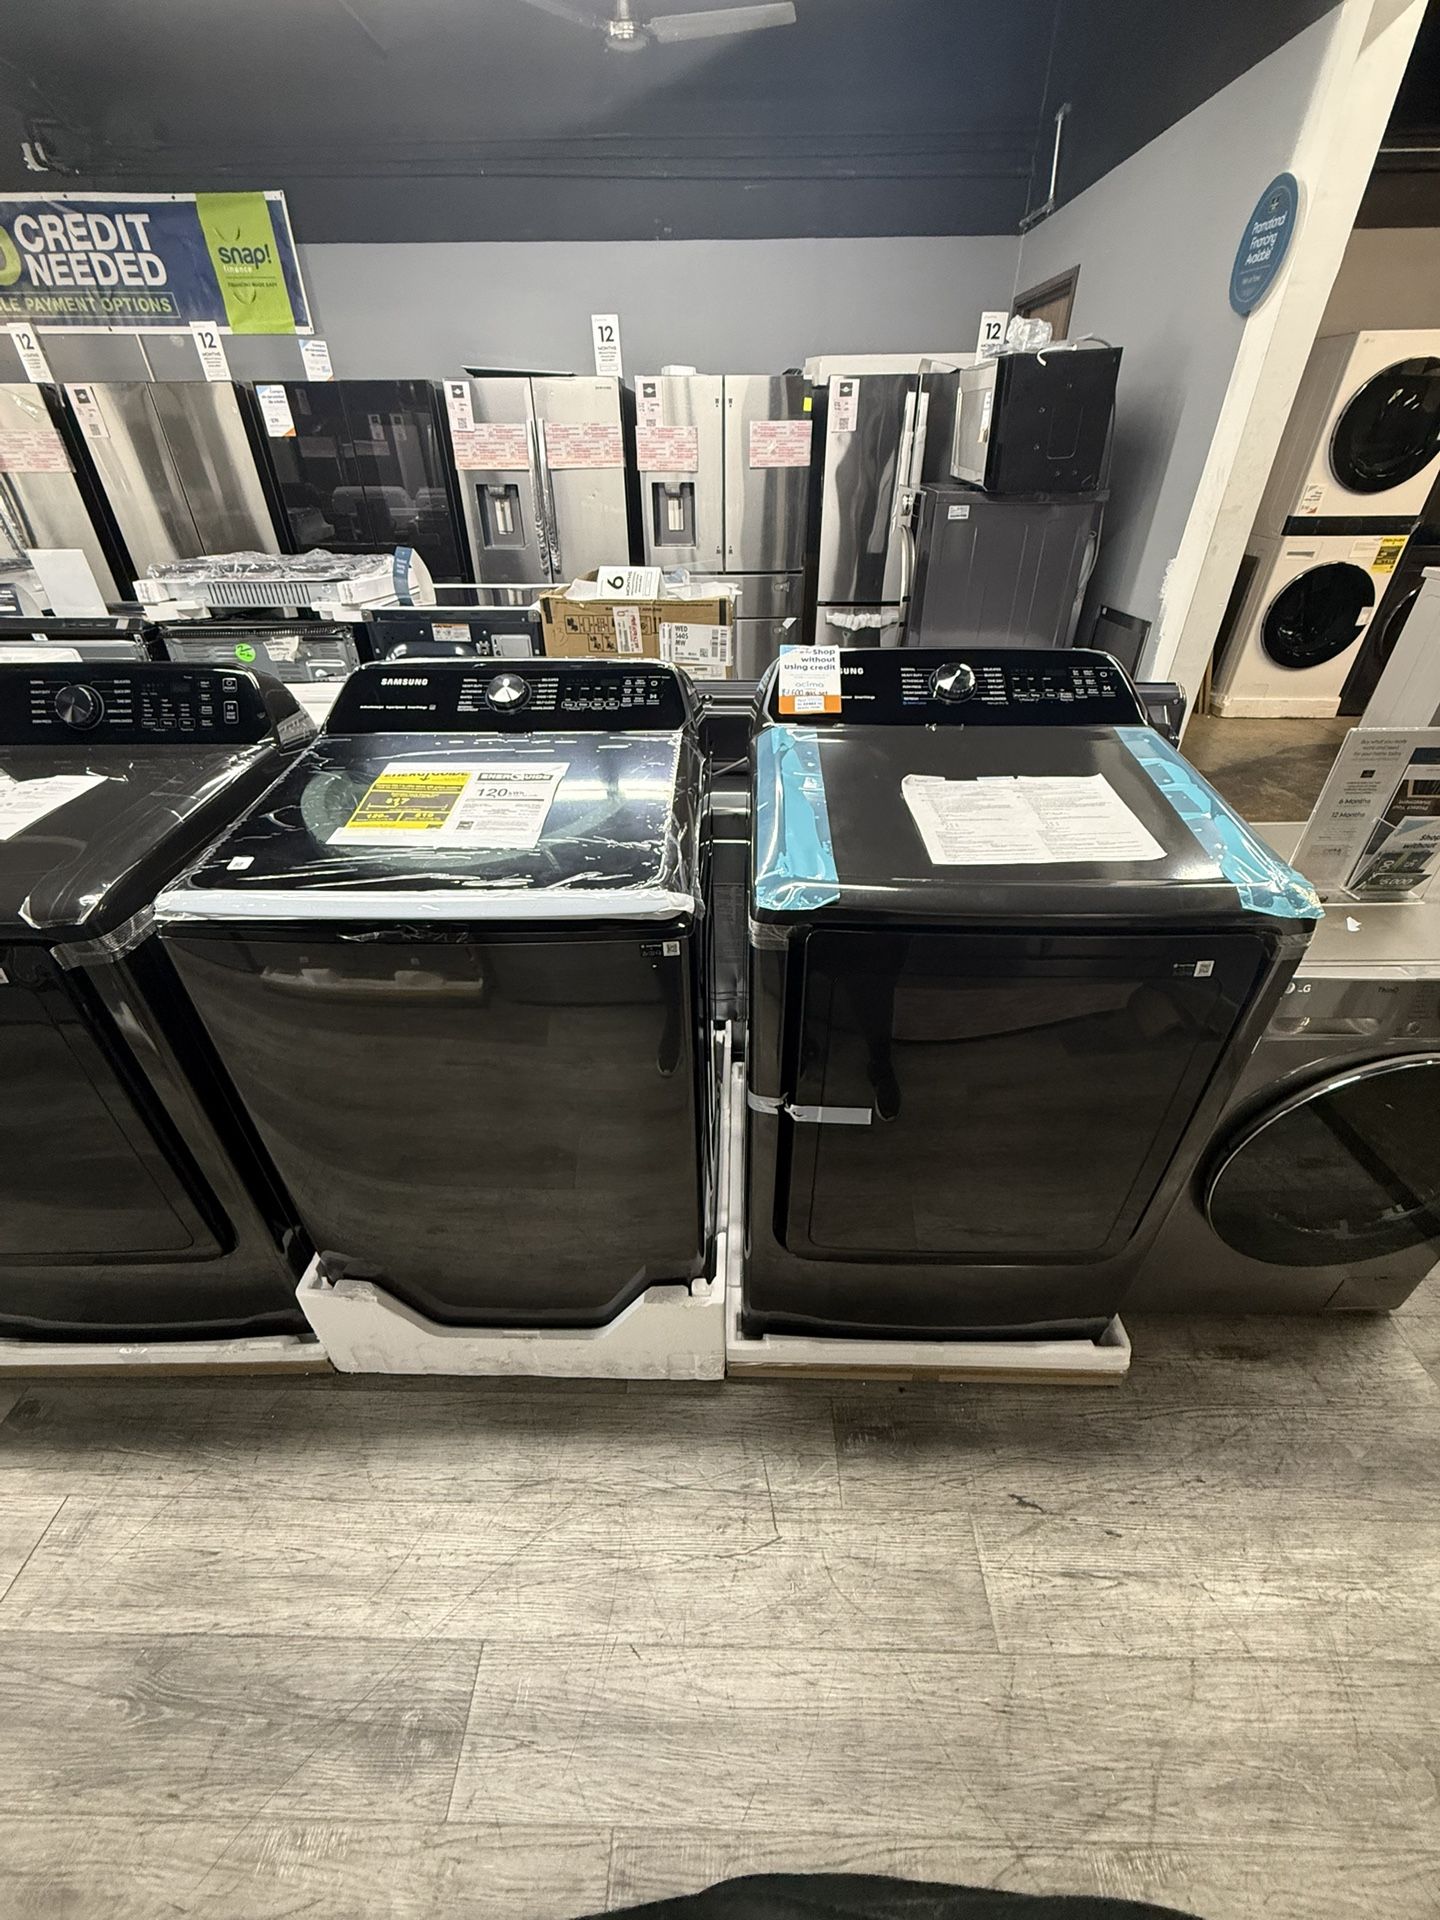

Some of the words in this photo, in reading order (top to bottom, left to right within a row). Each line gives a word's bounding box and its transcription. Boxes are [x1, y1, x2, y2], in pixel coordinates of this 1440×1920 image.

[1251, 211, 1288, 235] Promotional
[14, 213, 152, 253] CREDIT
[1249, 232, 1277, 250] Financing
[218, 244, 272, 269] snap!
[1244, 248, 1273, 266] Available
[24, 252, 168, 287] NEEDED
[25, 296, 98, 313] PAYMENT
[101, 296, 173, 313] OPTIONS
[598, 325, 614, 342] 12
[986, 323, 1001, 340] 12
[16, 333, 35, 350] 12
[198, 332, 217, 349] 12
[784, 663, 808, 671] using
[380, 677, 428, 686] SAMSUNG
[478, 788, 508, 798] 120
